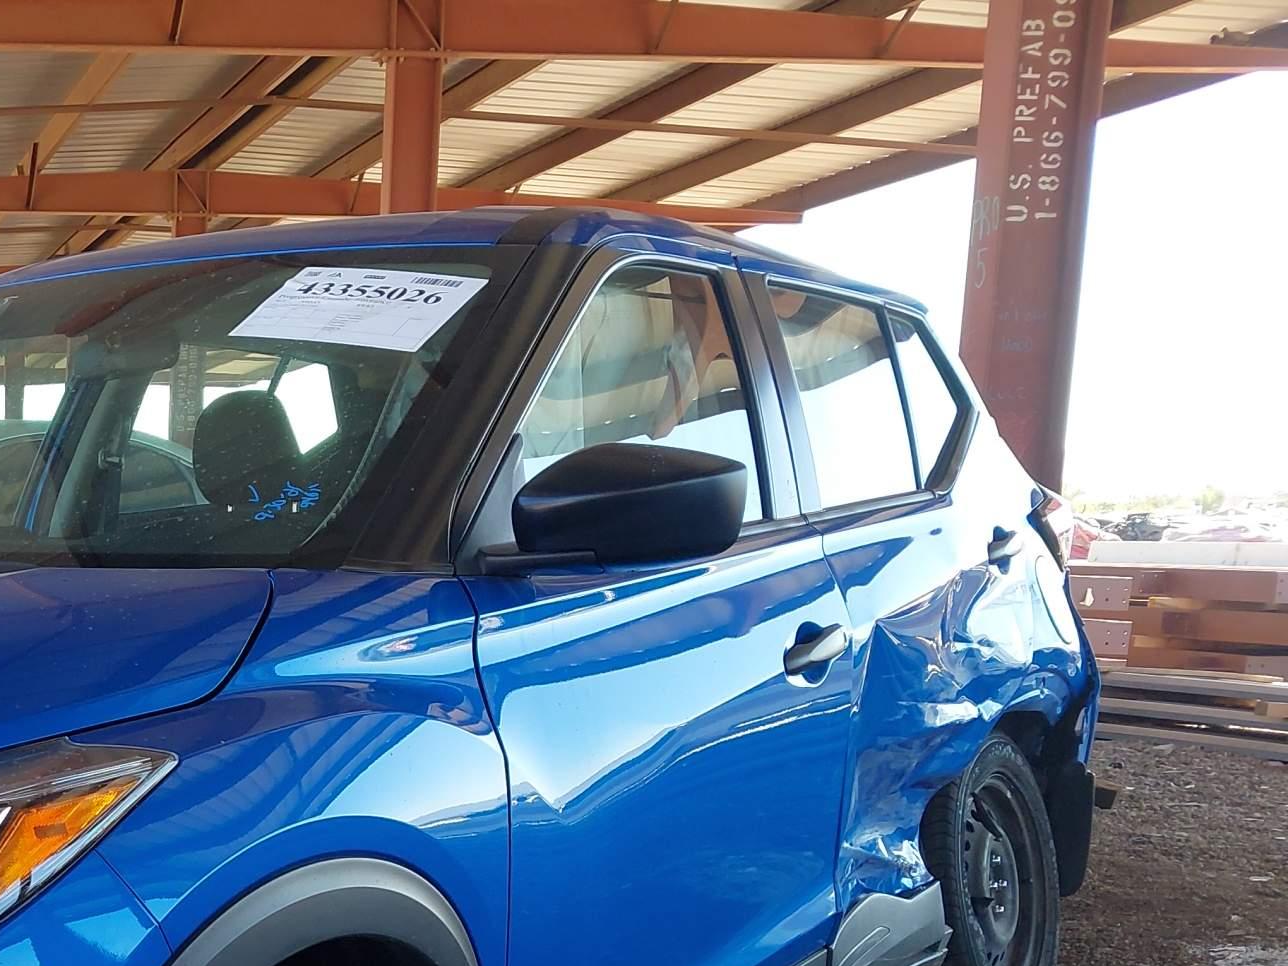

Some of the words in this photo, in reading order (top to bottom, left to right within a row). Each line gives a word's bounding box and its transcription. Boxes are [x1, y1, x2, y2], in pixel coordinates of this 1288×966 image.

[1012, 18, 1046, 144] PREFAB
[1034, 0, 1077, 221] 1-866-799-0
[1005, 164, 1033, 223] U.S.
[297, 281, 448, 305] 43355026
